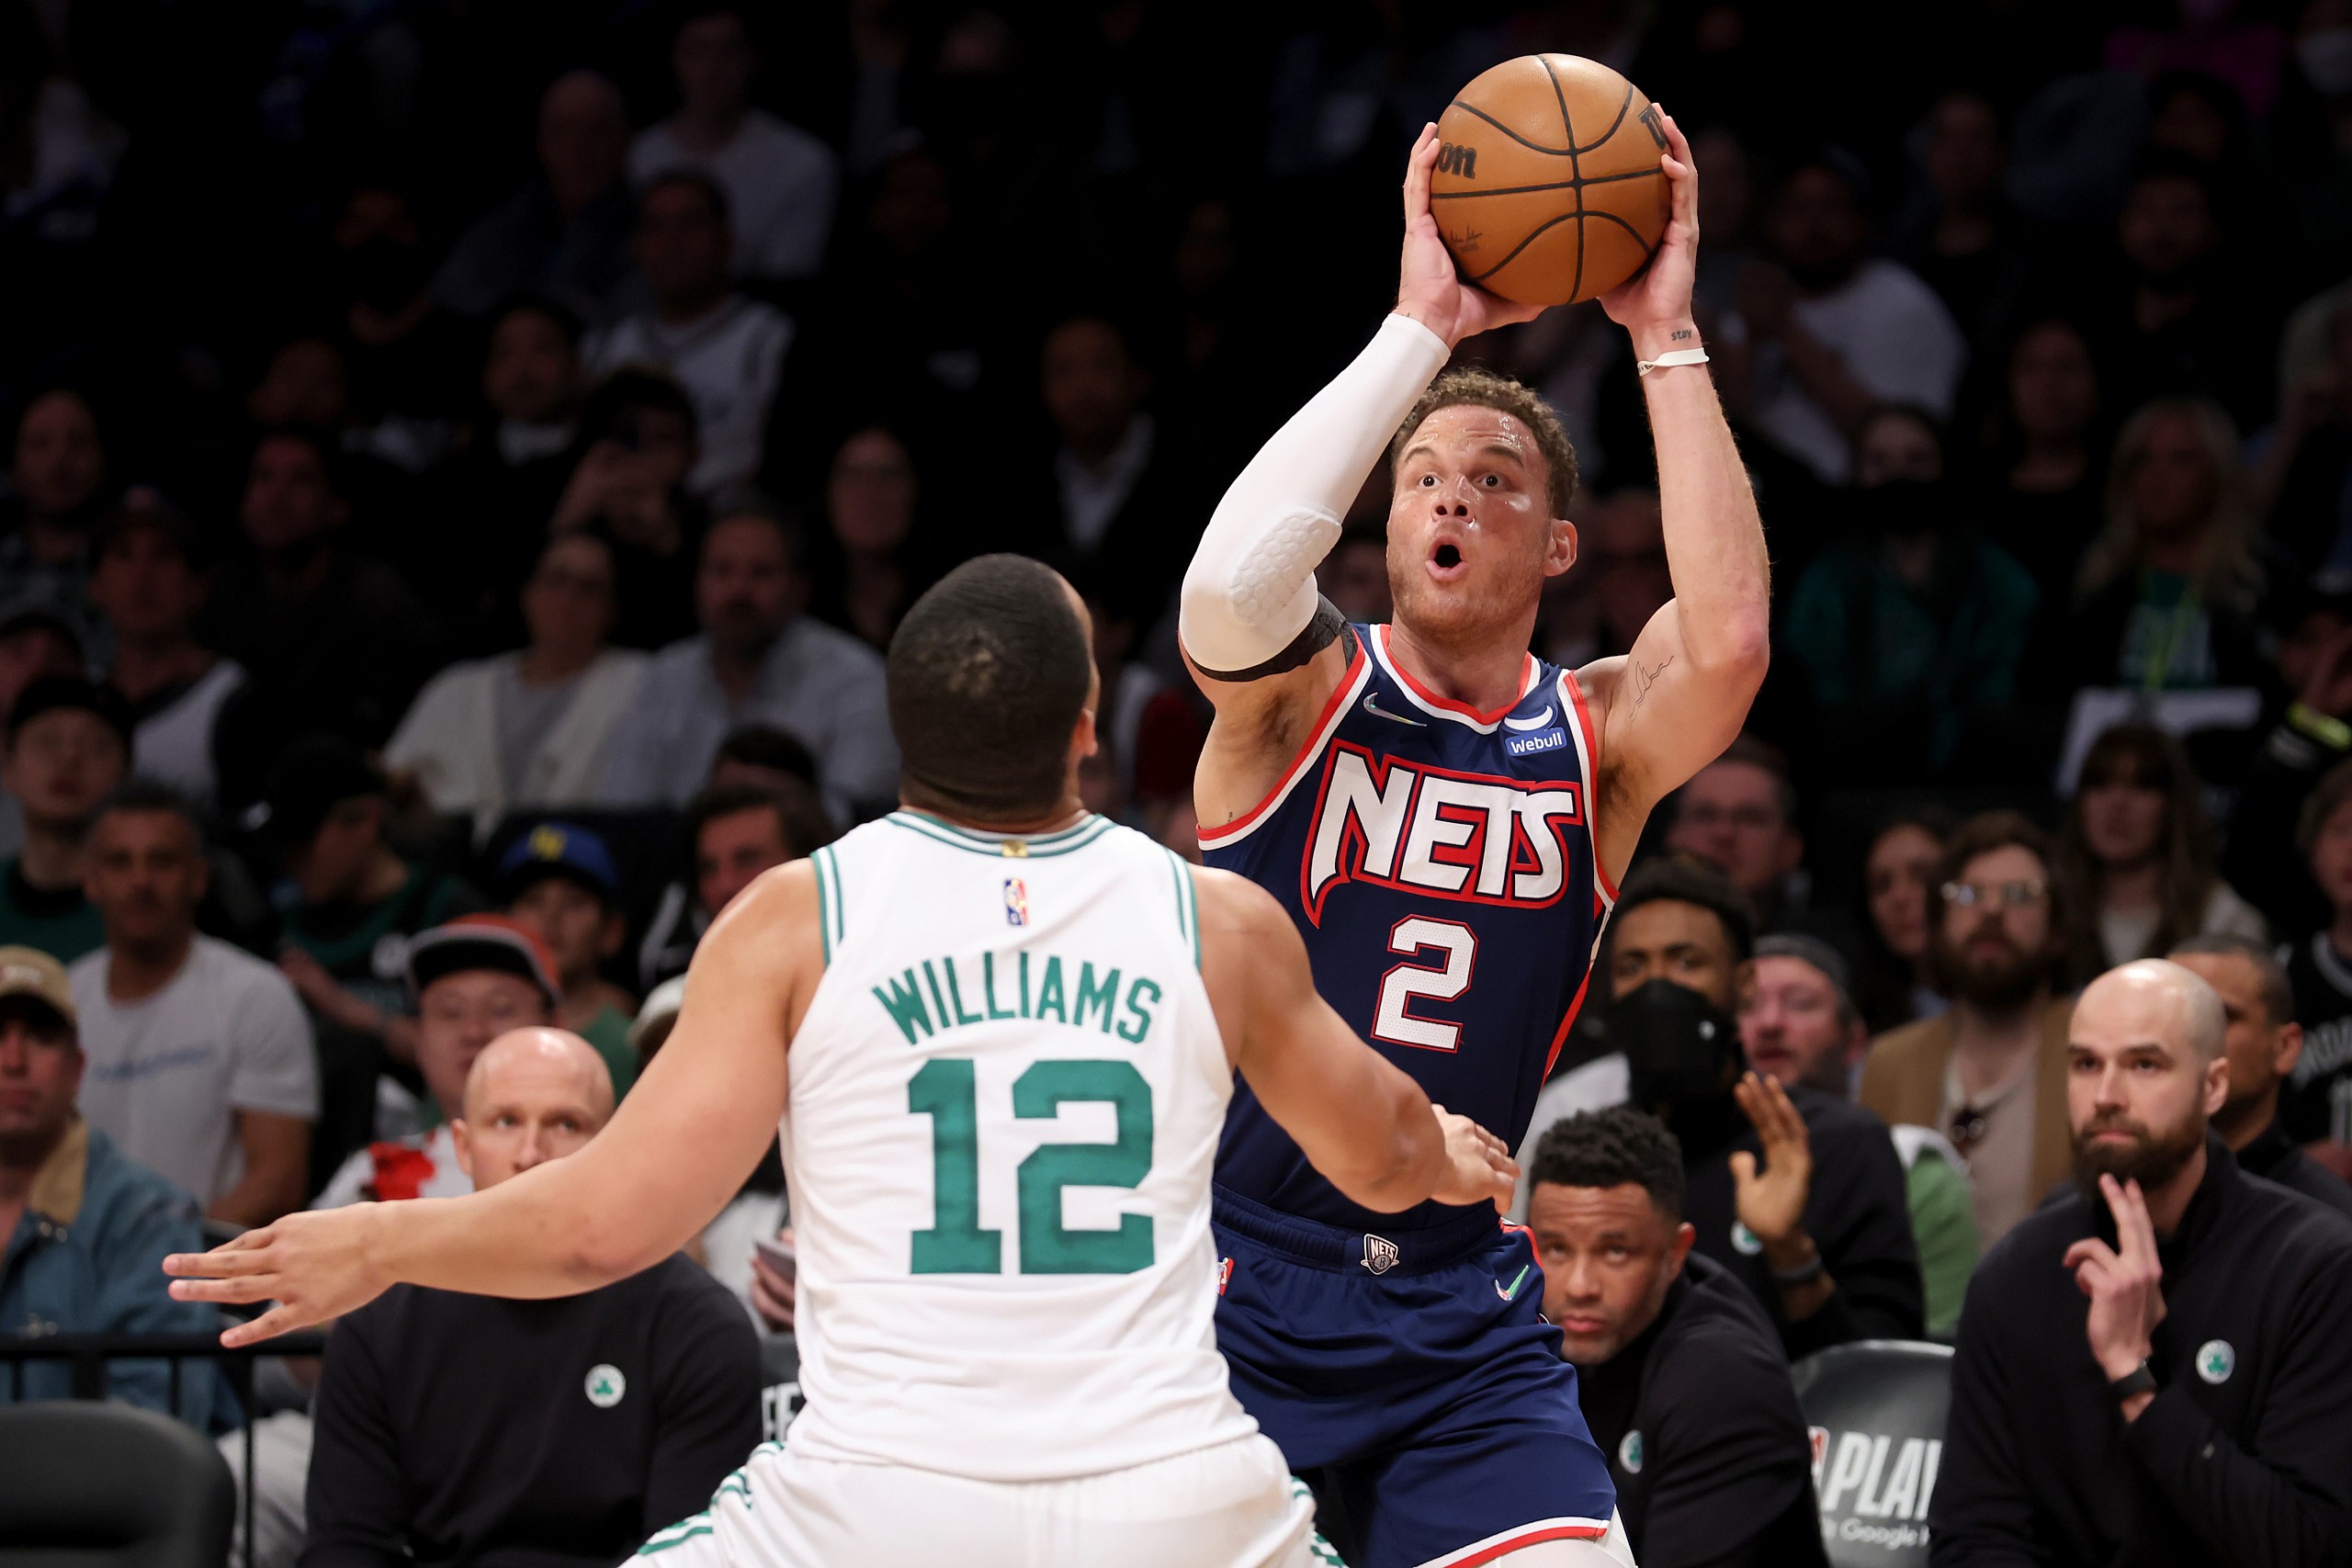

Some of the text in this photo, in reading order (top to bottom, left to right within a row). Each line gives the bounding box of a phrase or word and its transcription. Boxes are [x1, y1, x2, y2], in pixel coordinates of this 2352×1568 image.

[1670, 329, 1691, 341] stay
[1510, 731, 1563, 754] Webull
[1303, 739, 1584, 927] NETS
[871, 951, 1162, 1046] WILLIAMS
[1370, 913, 1479, 1054] 2
[907, 1057, 1156, 1275] 12
[1370, 1237, 1396, 1261] NETS
[1838, 1517, 1918, 1551] Google
